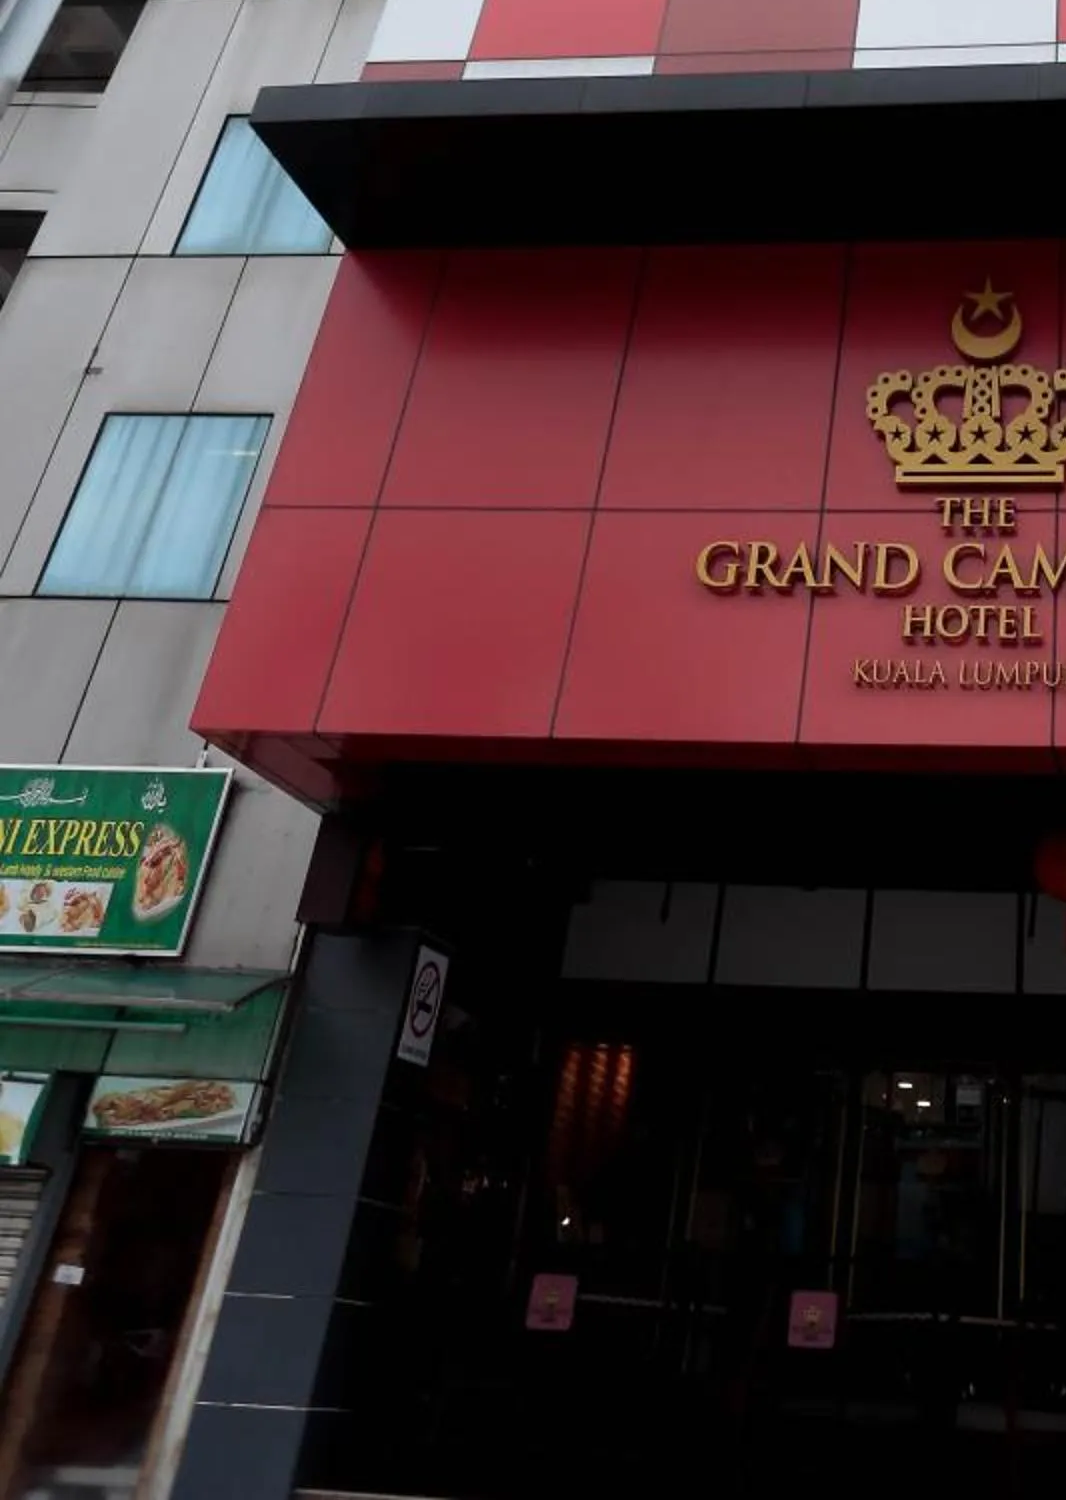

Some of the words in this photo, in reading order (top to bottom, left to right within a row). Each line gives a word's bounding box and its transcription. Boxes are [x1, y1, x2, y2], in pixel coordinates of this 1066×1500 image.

[935, 497, 1016, 528] THE
[695, 541, 920, 591] GRAND
[902, 603, 1044, 639] HOTEL
[853, 658, 946, 684] KUALA
[20, 819, 144, 857] EXPRESS
